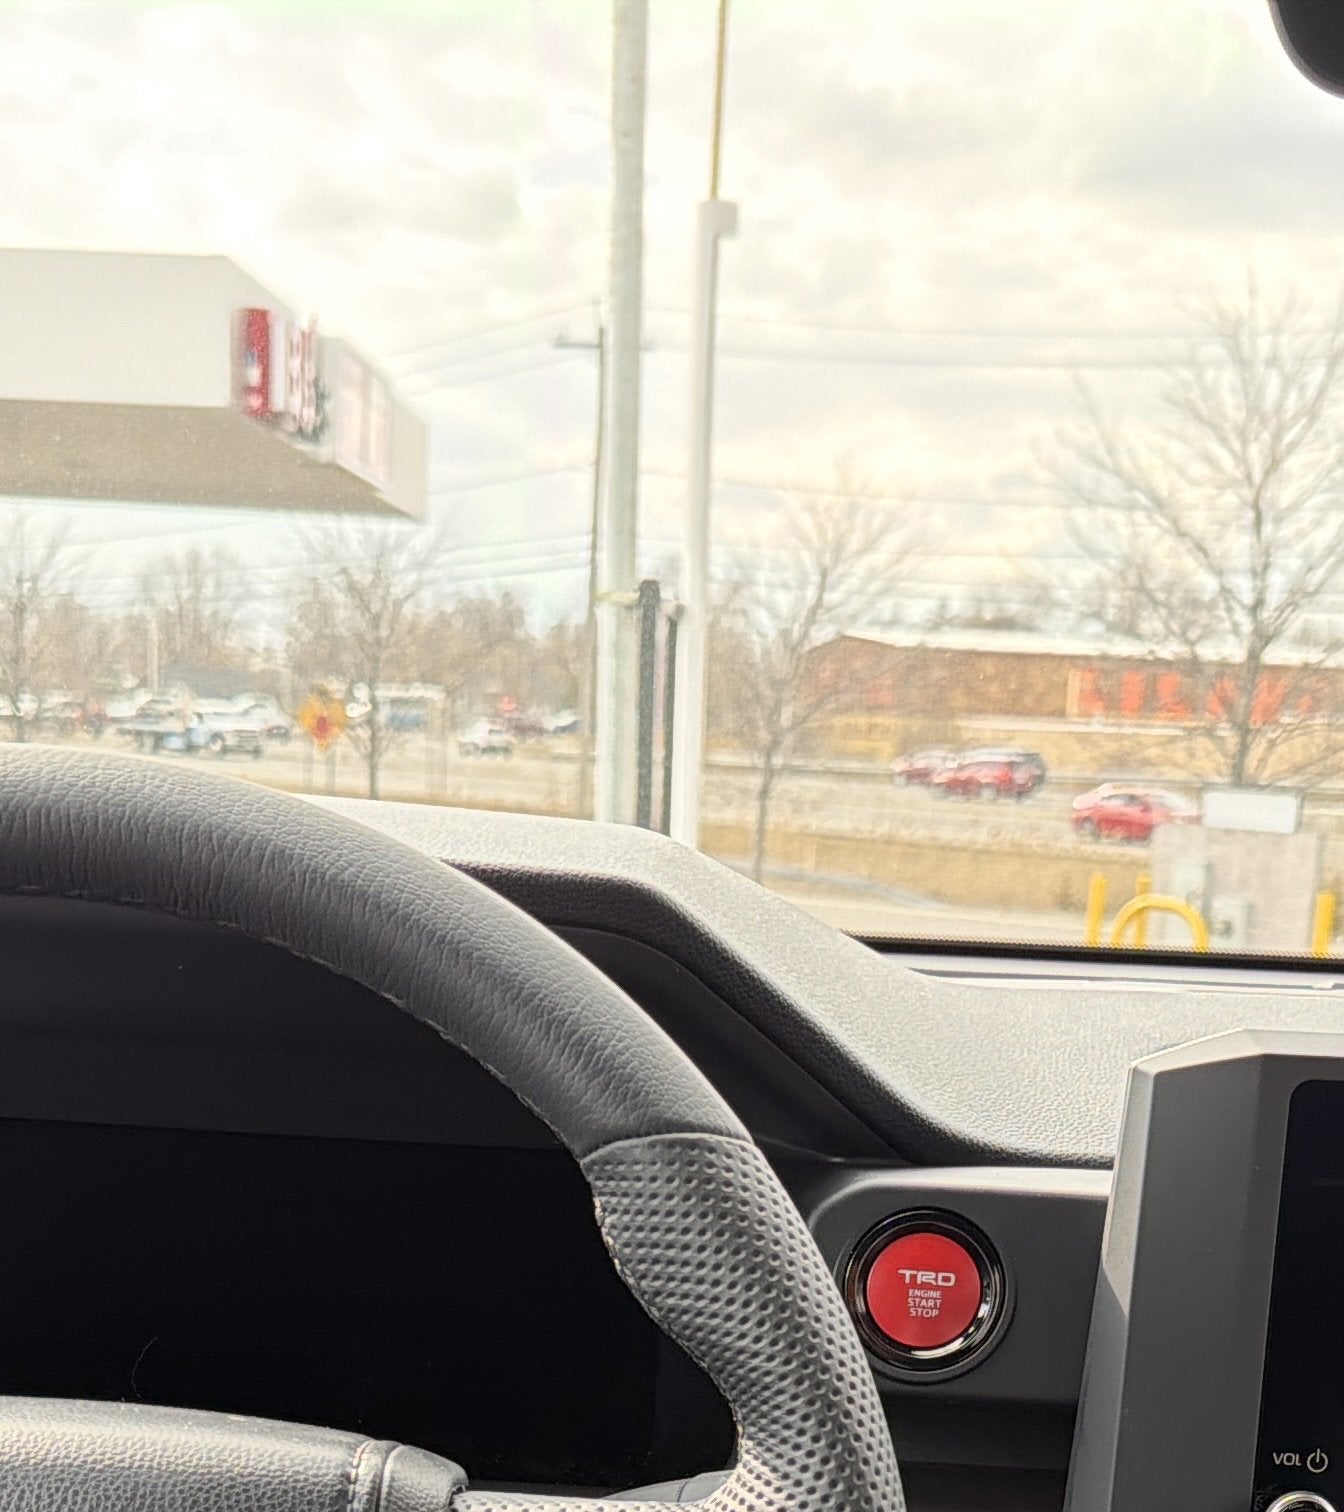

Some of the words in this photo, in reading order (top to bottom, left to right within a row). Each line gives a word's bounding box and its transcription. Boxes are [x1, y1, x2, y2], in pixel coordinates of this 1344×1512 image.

[897, 1268, 956, 1287] TRD
[908, 1288, 942, 1298] ENGINE
[907, 1297, 942, 1308] START
[909, 1307, 939, 1318] STOP
[1272, 1452, 1302, 1466] VOL
